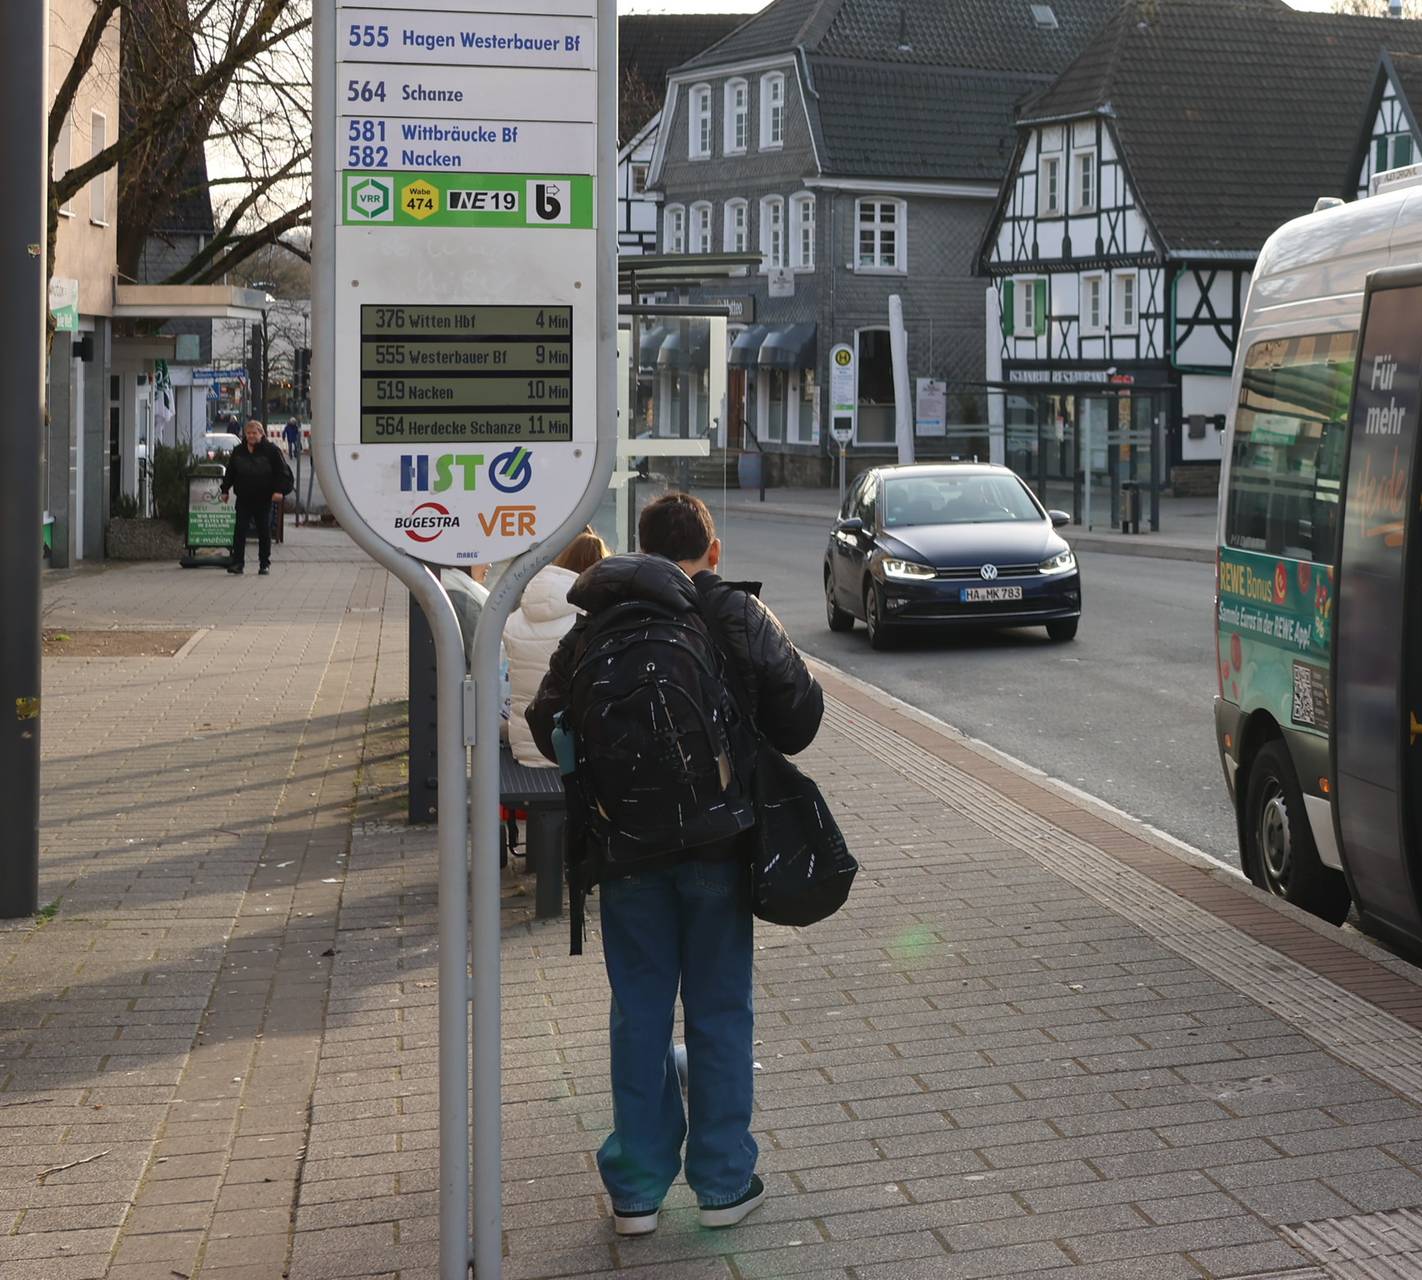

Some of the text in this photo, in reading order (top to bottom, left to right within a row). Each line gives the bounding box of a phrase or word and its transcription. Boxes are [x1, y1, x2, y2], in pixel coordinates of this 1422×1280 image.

[349, 25, 581, 51] 555 Hagen Westerbauer Bf
[347, 80, 463, 102] 564 Schanze
[348, 120, 518, 143] 581 Wittbräucke Bf
[348, 146, 461, 167] 582 Nacken
[360, 194, 381, 203] VRR
[409, 187, 431, 195] Wabe
[406, 198, 433, 210] 474
[376, 309, 568, 328] 376 Witten Hbf 4 Min
[376, 345, 568, 364] 555 Westerbauer Bf 9 Min
[1371, 354, 1398, 391] Für
[376, 380, 568, 399] 519 Nacken 10 Min
[376, 416, 568, 436] 564 Herdecke Schanze 11 Min
[1365, 398, 1406, 434] mehr
[400, 454, 484, 493] HST
[394, 516, 460, 529] BOGESTRA
[477, 505, 537, 537] VER
[1219, 561, 1272, 603] REWE Bonus
[966, 589, 980, 600] HA
[1001, 588, 1021, 598] 783
[1240, 607, 1256, 630] Euros
[1263, 613, 1273, 635] der
[1274, 615, 1294, 641] REWE
[1294, 621, 1312, 650] App!
